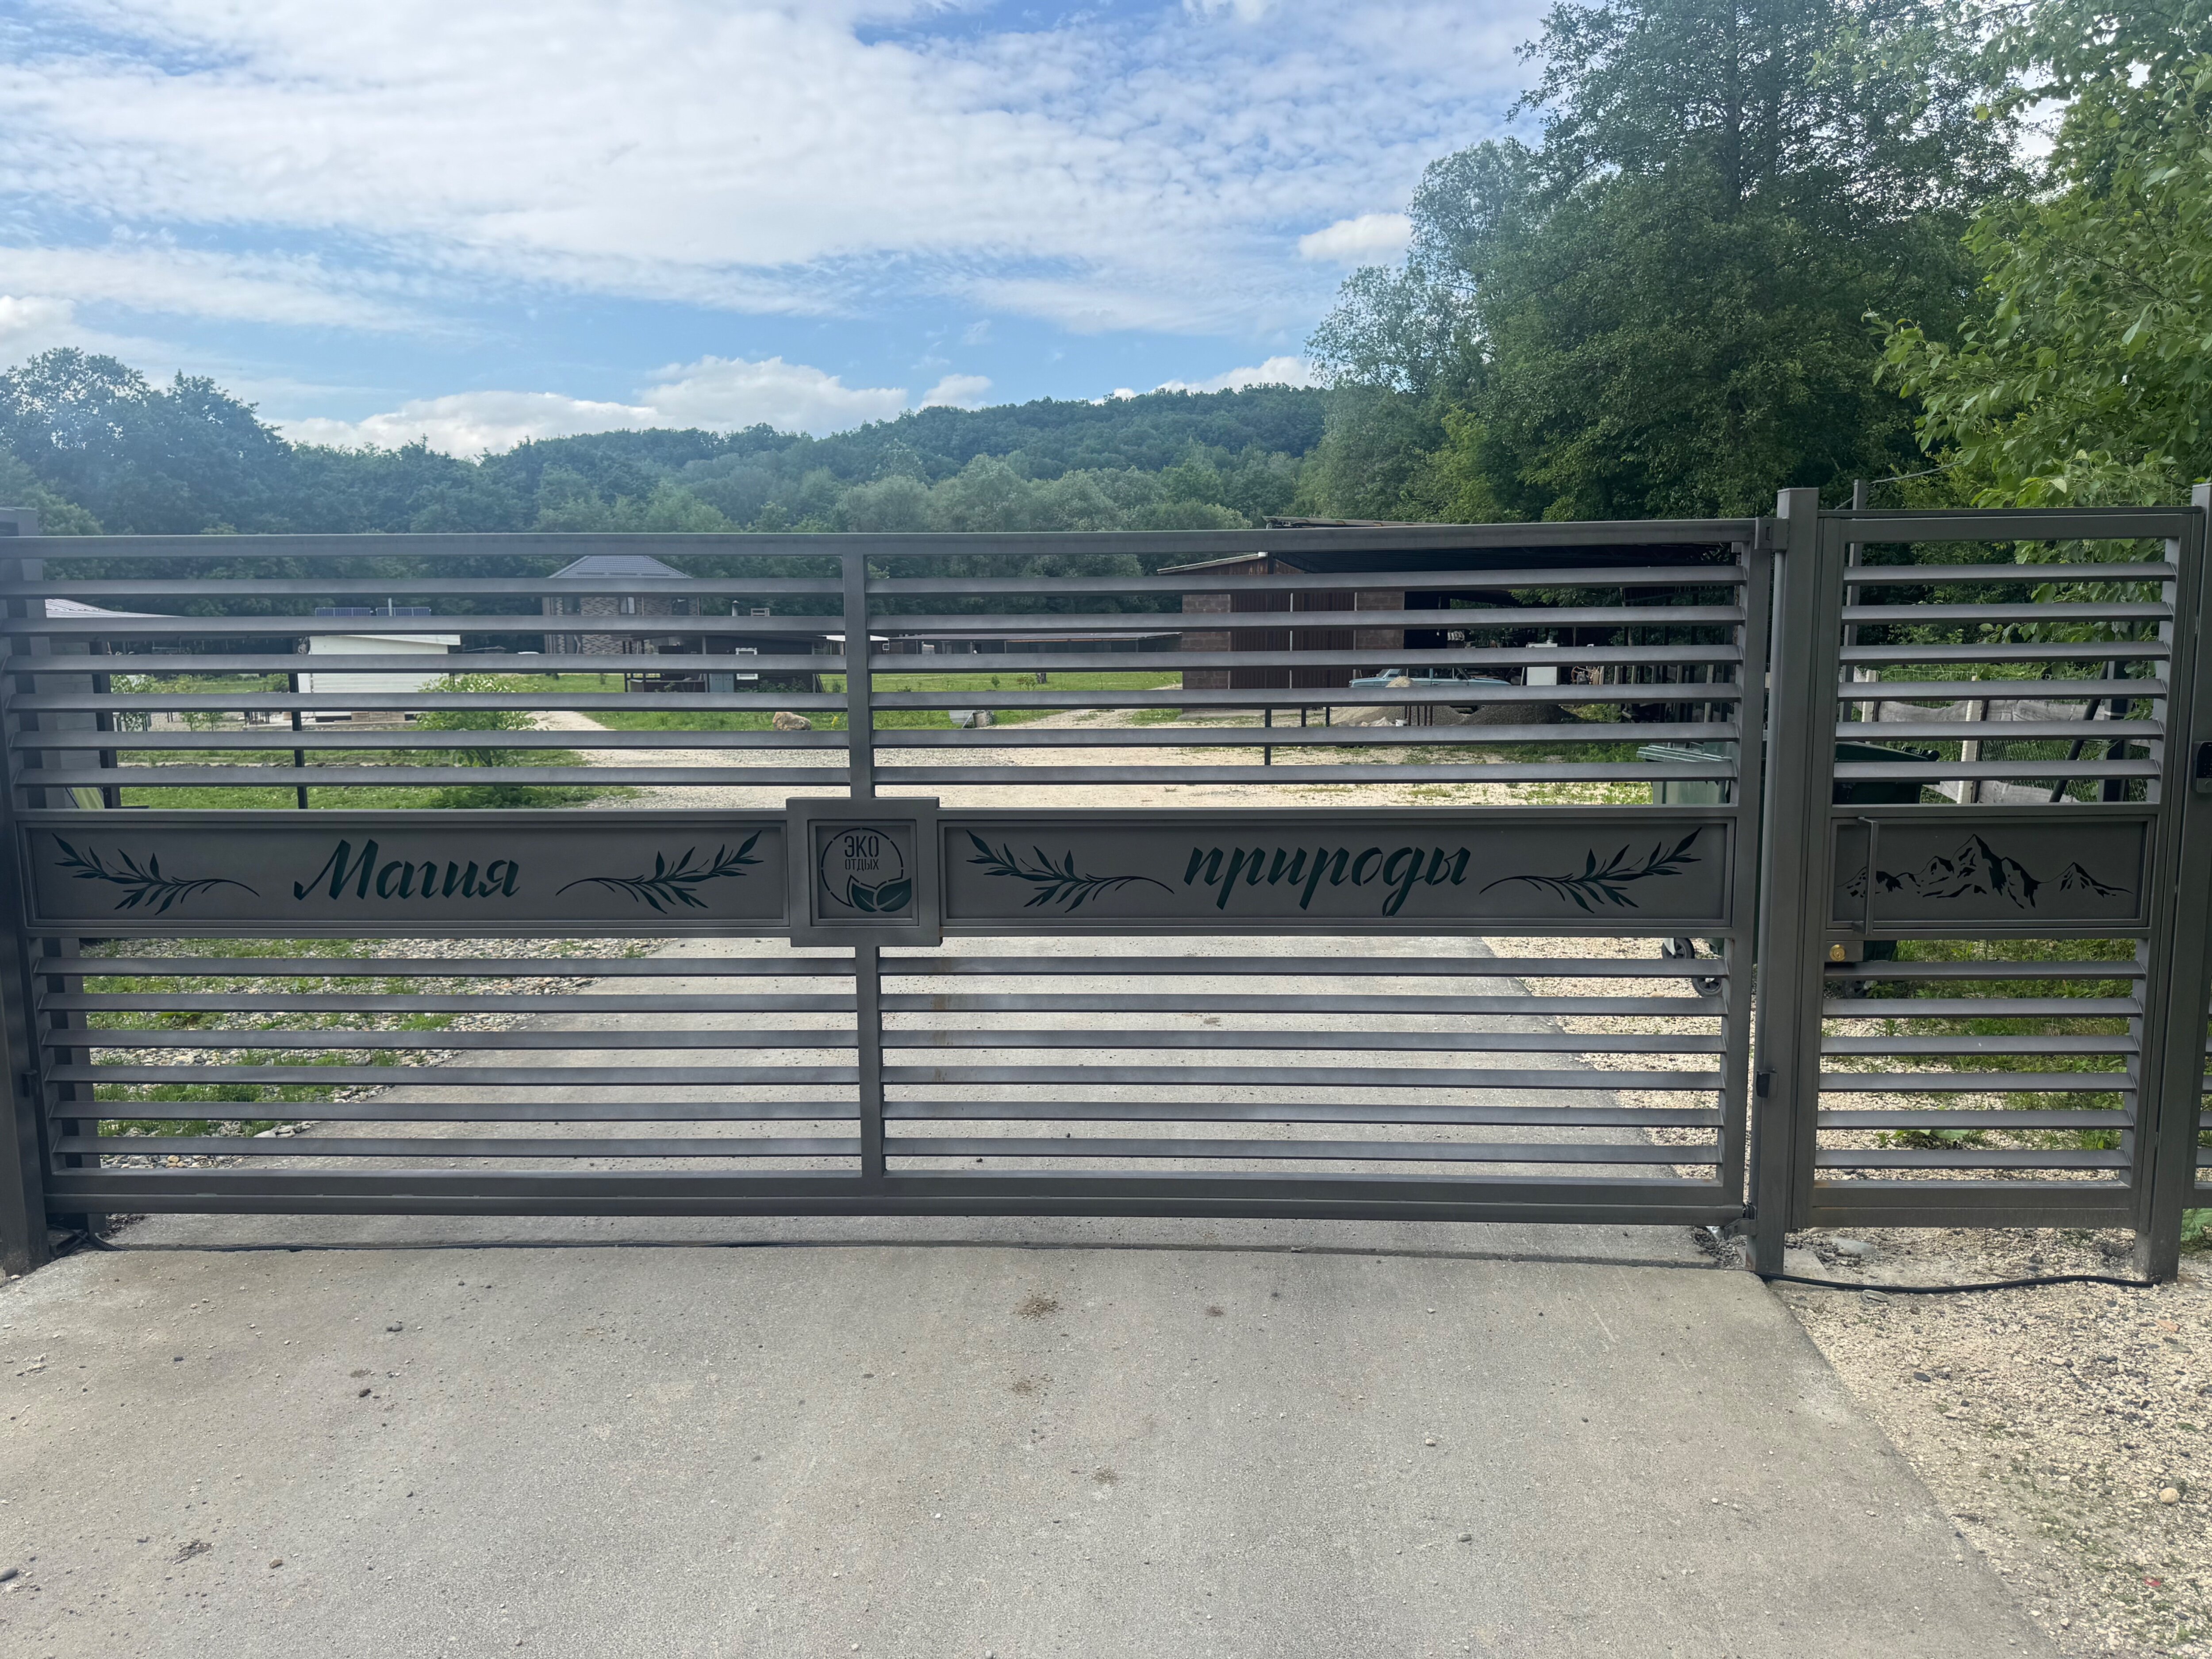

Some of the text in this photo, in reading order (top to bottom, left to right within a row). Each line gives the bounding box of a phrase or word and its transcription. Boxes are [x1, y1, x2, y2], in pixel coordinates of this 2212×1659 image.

[844, 836, 879, 857] ЭКО
[845, 858, 879, 872] ОТДЫХ
[294, 839, 520, 900] Магия
[1183, 847, 1471, 917] природы
